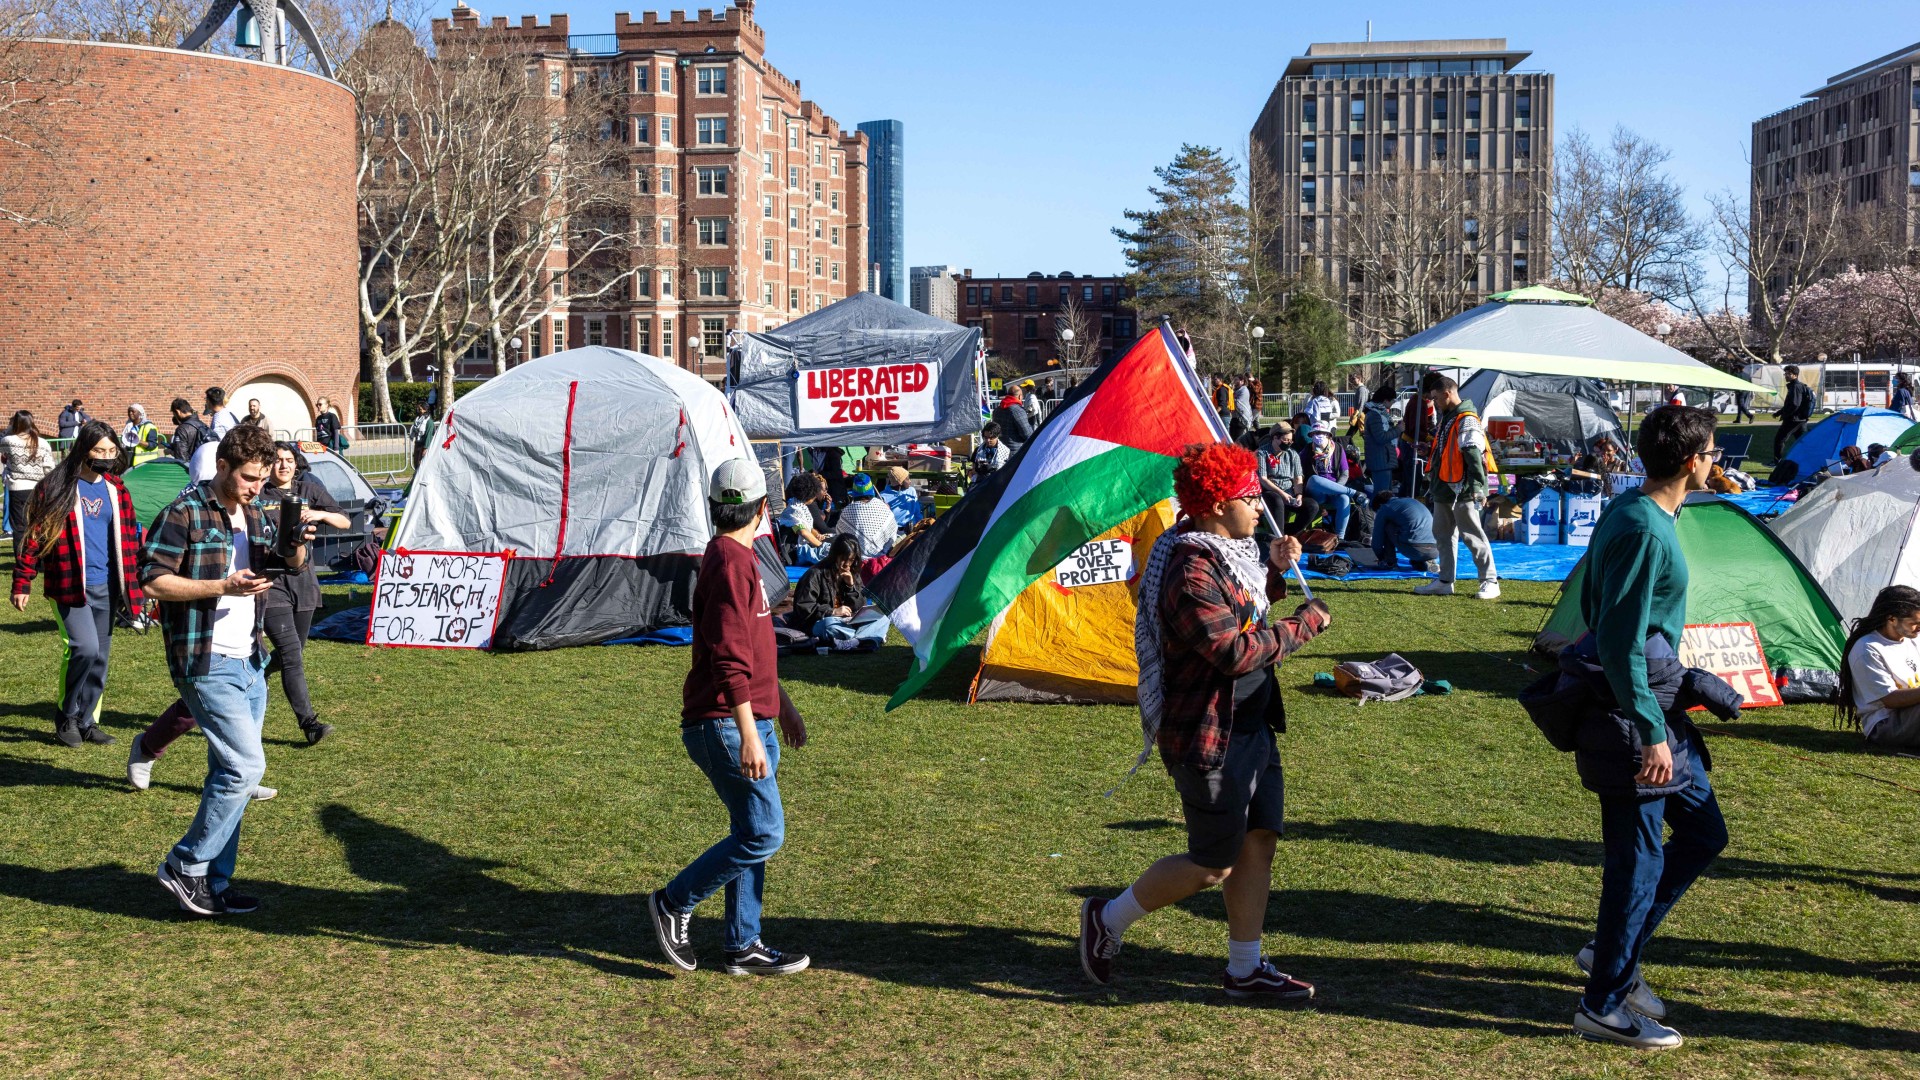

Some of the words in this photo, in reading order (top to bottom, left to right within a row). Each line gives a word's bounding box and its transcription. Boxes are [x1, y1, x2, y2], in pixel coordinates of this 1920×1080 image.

[807, 363, 930, 399] LIBERATED
[829, 396, 900, 424] ZONE
[1611, 475, 1631, 486] MIT
[1068, 539, 1123, 559] OPLE
[381, 555, 415, 579] NO
[427, 555, 493, 580] MORE
[1076, 555, 1114, 570] OVER
[1059, 565, 1122, 586] PROFIT
[378, 582, 486, 611] RESEARCH
[373, 616, 415, 642] FOR
[429, 615, 485, 644] IOF
[1705, 627, 1756, 650] KIDS
[1686, 653, 1715, 669] NOT
[1720, 651, 1761, 668] BORN
[1716, 669, 1773, 702] TE
